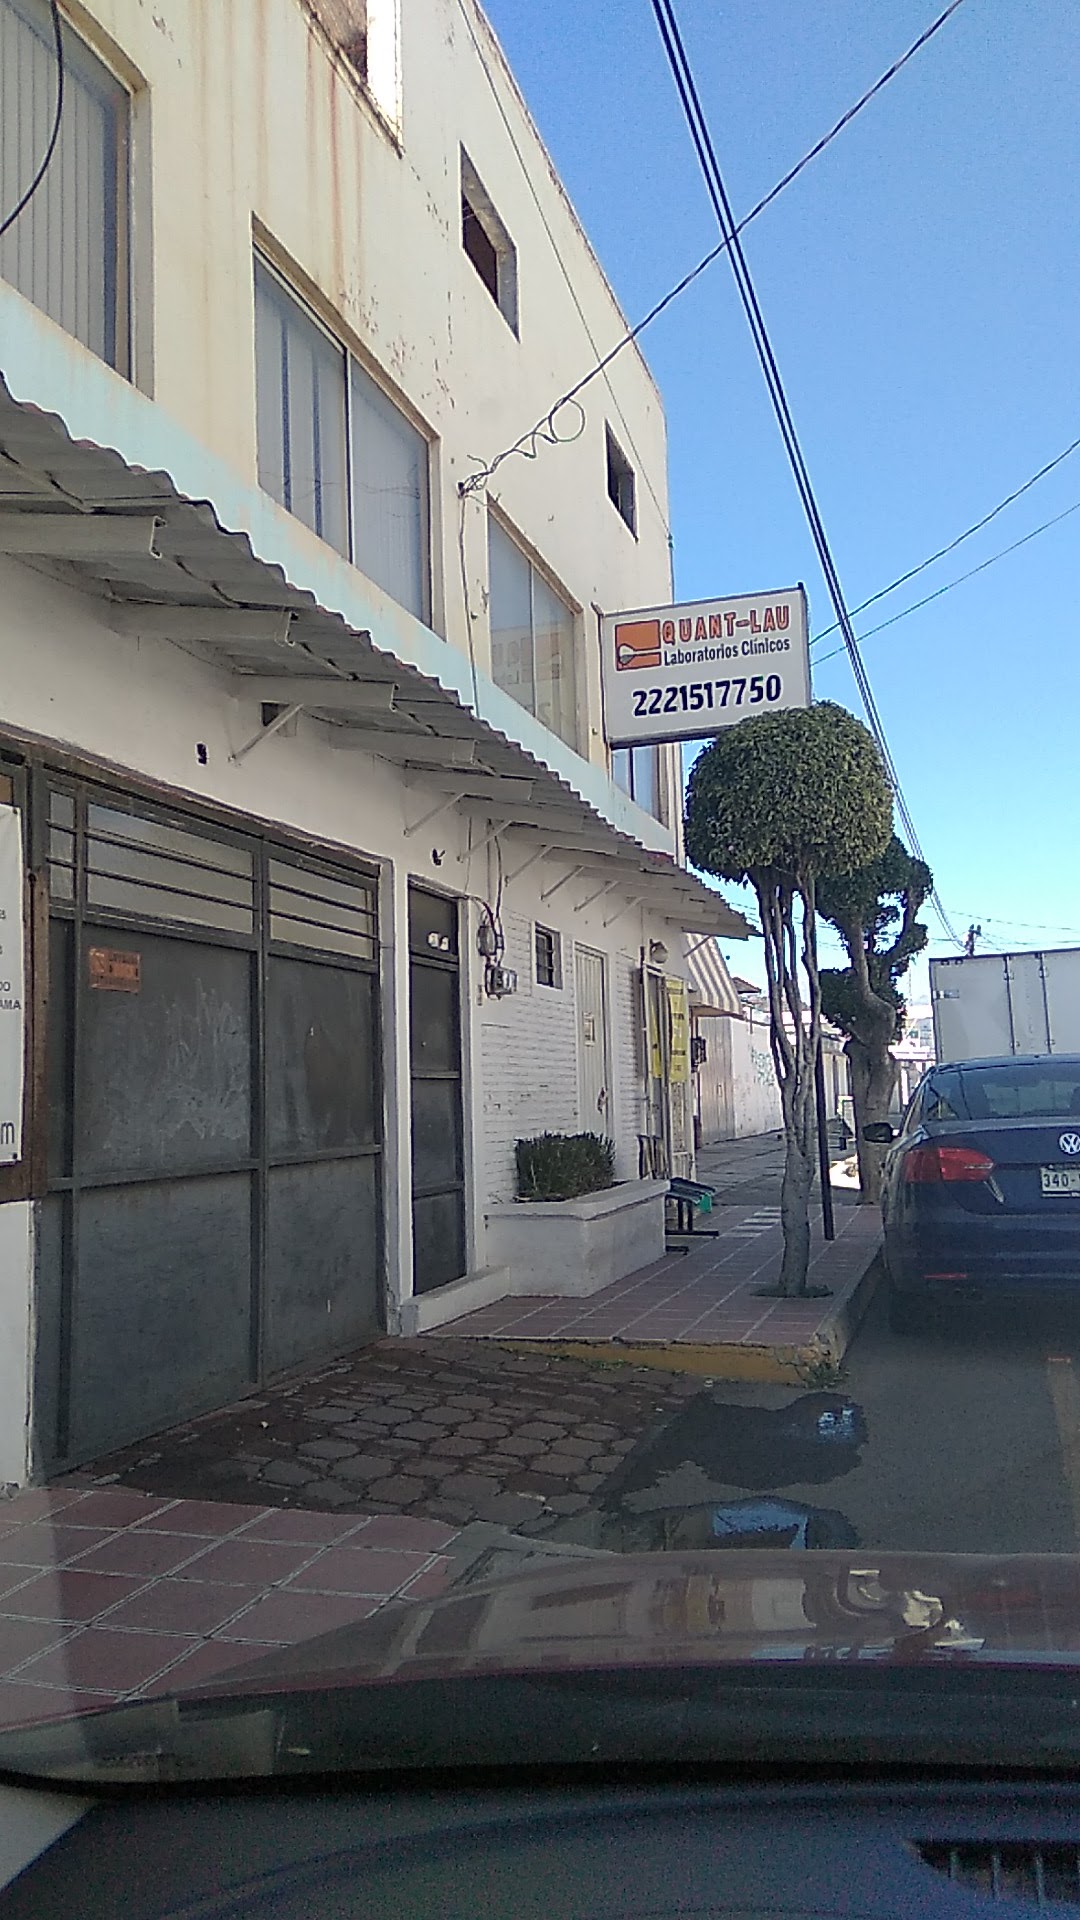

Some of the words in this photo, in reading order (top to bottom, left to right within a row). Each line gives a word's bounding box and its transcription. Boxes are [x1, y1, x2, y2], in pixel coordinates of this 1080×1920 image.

[662, 605, 789, 646] QUANT-LAU
[664, 643, 739, 666] Laboratorios
[741, 637, 790, 656] Clínicos
[632, 674, 782, 717] 2221517750
[1043, 1173, 1080, 1188] 340-
